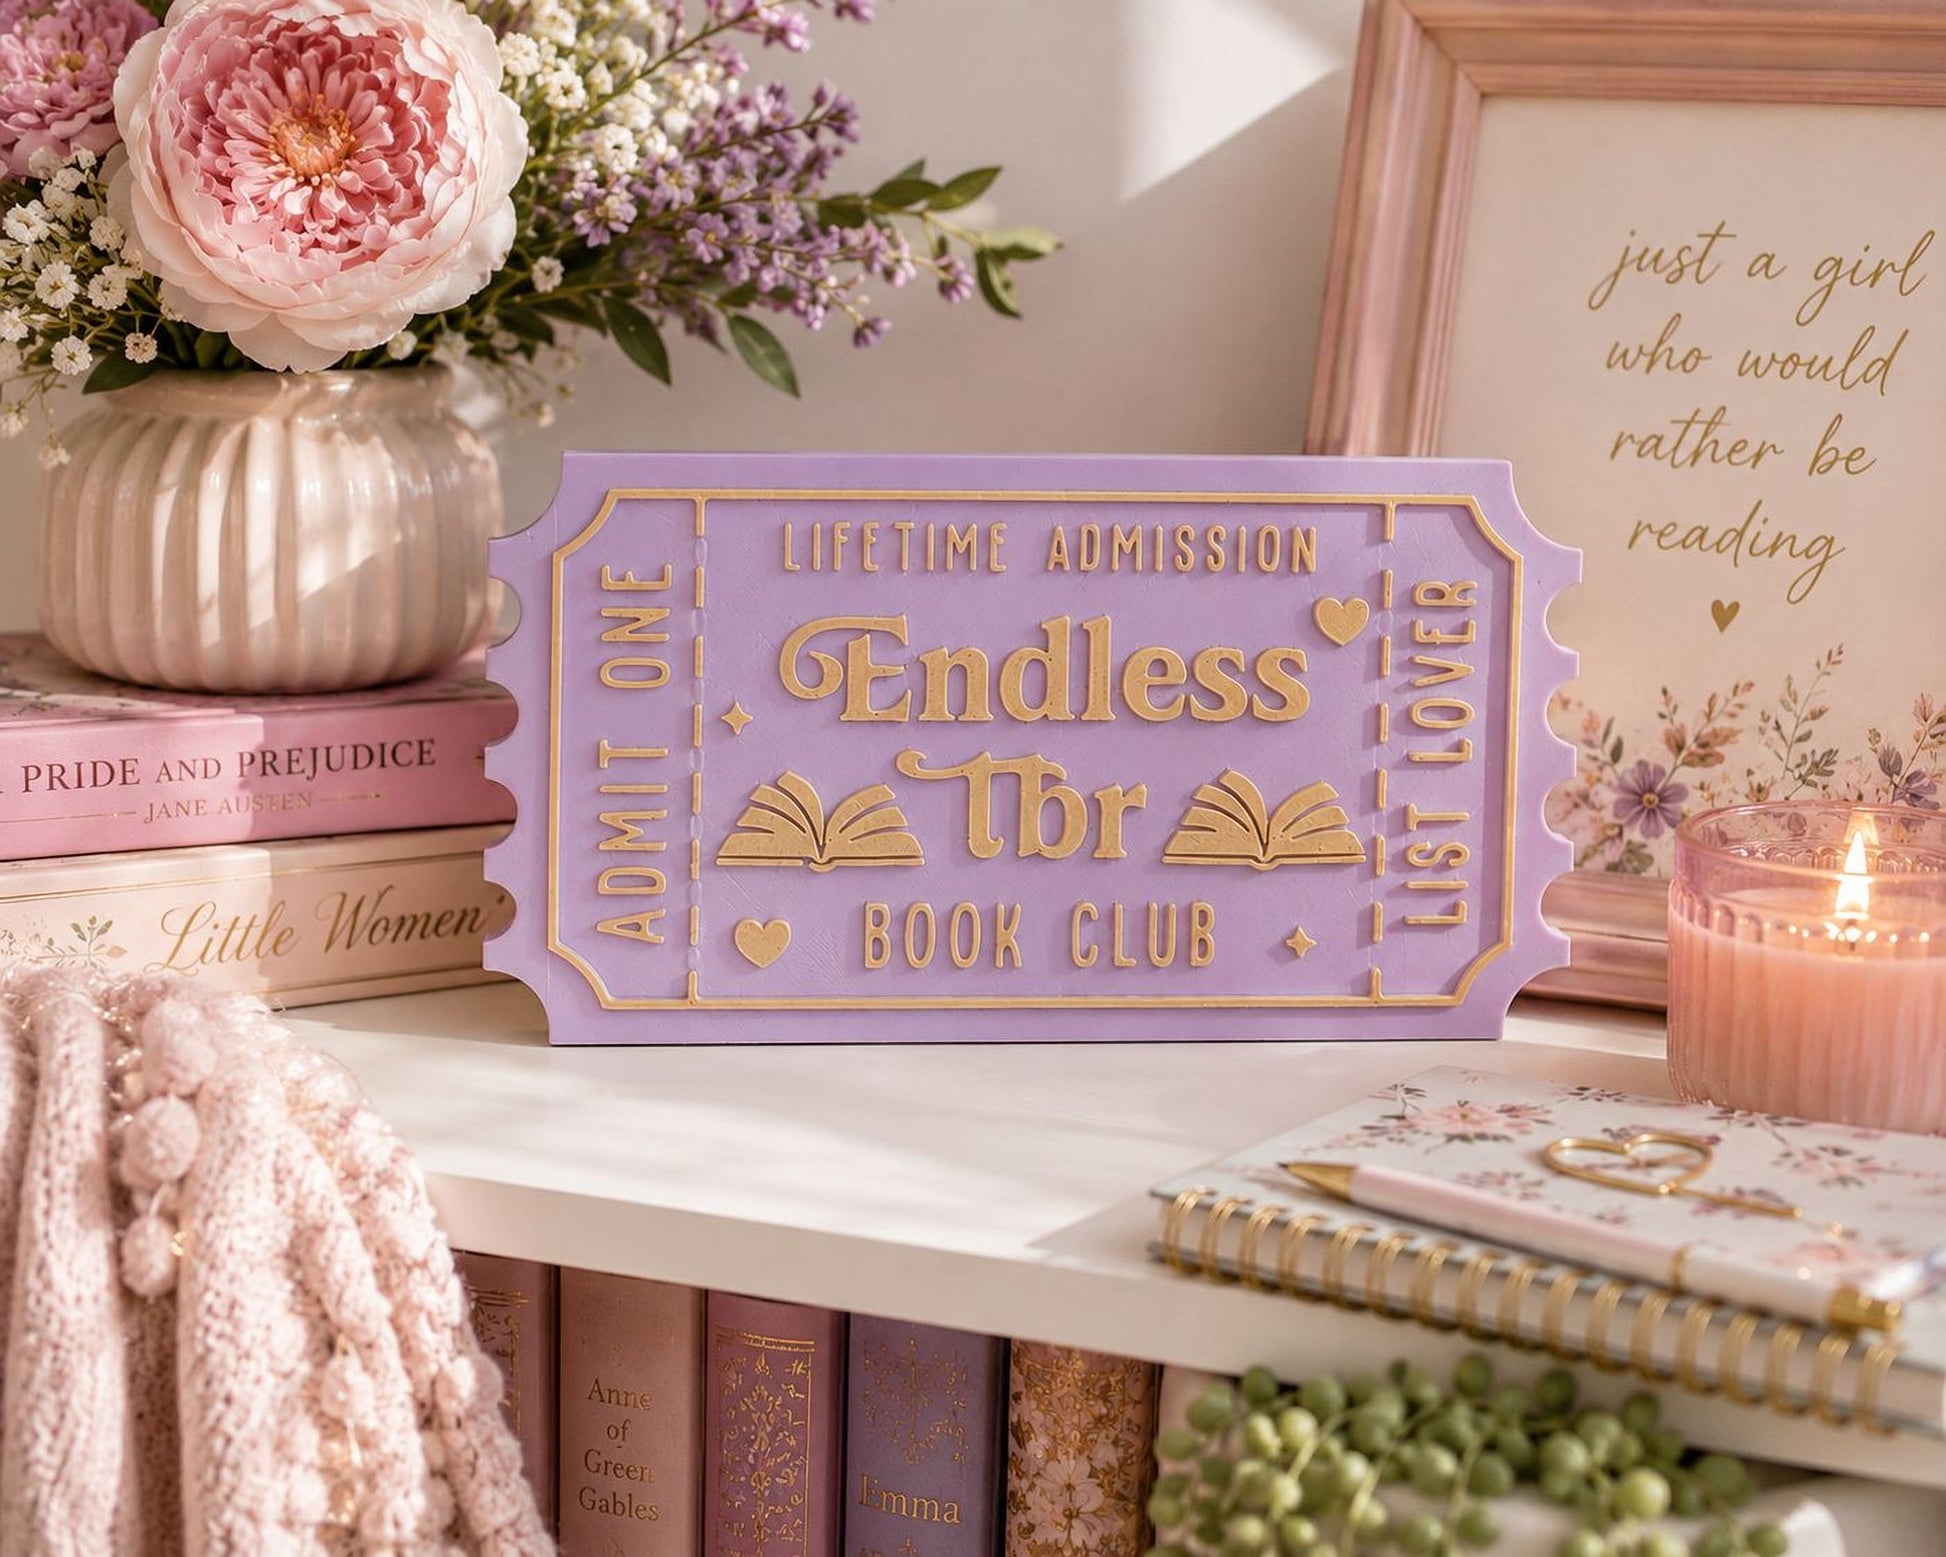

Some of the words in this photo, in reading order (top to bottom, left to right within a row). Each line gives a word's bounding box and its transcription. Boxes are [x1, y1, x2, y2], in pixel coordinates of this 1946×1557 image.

[1588, 220, 1737, 310] just
[1747, 250, 1787, 280] a
[1795, 229, 1936, 327] girl
[1605, 312, 1712, 375] who
[1737, 325, 1910, 396] would
[1610, 405, 1785, 470] rather
[1808, 413, 1877, 477] be
[783, 521, 1008, 573] LIFETIME
[1046, 524, 1318, 573] ADMISSION
[1627, 499, 1846, 604] reading
[599, 562, 673, 689] ONE
[778, 612, 1311, 723] Endless
[1407, 579, 1479, 763] LOVER
[21, 757, 141, 793] PRIDE
[155, 756, 222, 784] AND
[237, 738, 437, 780] PREJUDICE
[144, 800, 208, 824] JANE
[217, 792, 313, 815] AUSTEN
[596, 738, 669, 945] ADMIT
[1403, 802, 1471, 925] LIST
[144, 900, 300, 977] Little
[314, 884, 489, 954] Women
[864, 901, 1022, 969] BOOK
[1070, 901, 1216, 968] CLUB
[588, 1378, 653, 1411] Anne
[607, 1418, 632, 1442] of
[584, 1448, 655, 1484] Green
[860, 1474, 961, 1524] Emma
[578, 1486, 661, 1522] Gables
